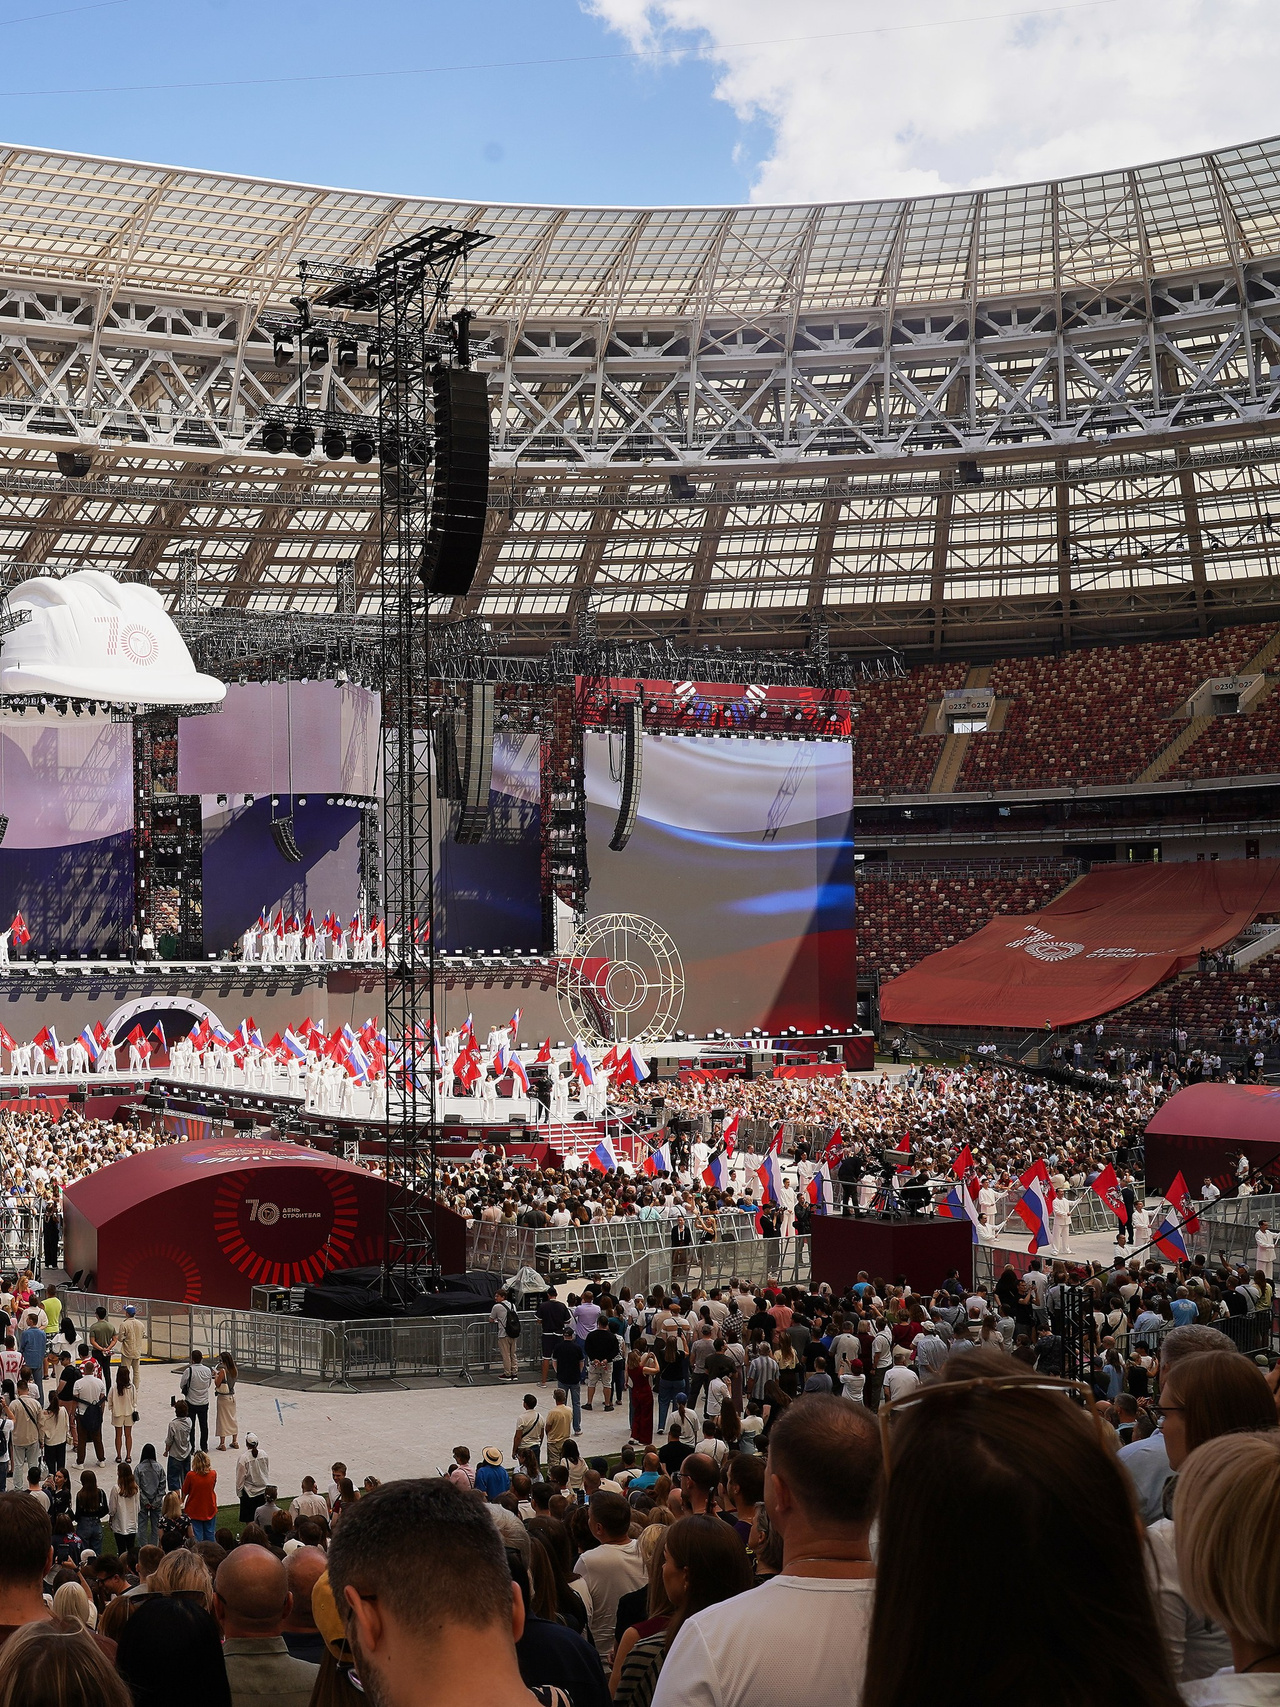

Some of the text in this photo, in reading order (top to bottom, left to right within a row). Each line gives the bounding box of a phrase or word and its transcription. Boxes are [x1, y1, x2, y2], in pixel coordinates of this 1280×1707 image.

[93, 616, 159, 666] 70
[245, 1199, 280, 1225] 70
[5, 1360, 19, 1373] 12
